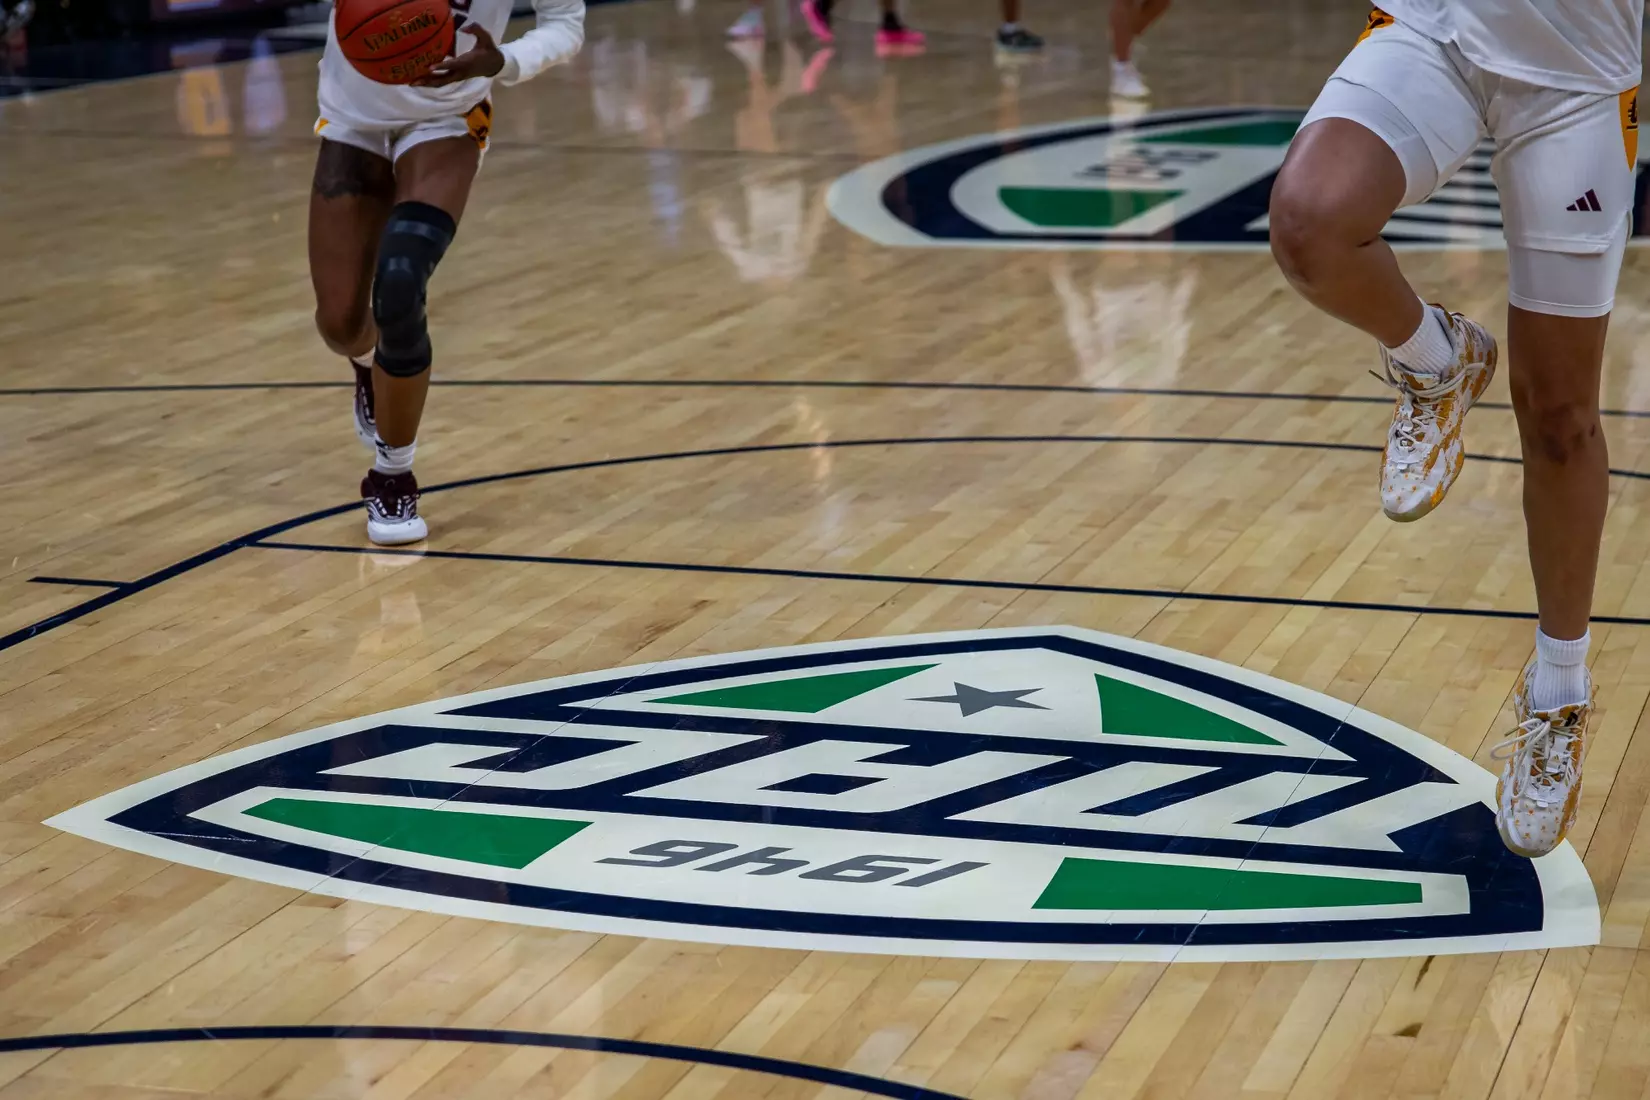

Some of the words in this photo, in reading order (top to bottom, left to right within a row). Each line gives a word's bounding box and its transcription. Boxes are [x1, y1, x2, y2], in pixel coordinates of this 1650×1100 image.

[363, 9, 437, 51] SPALDING
[316, 716, 1459, 852] MAC
[593, 839, 991, 887] 1946
